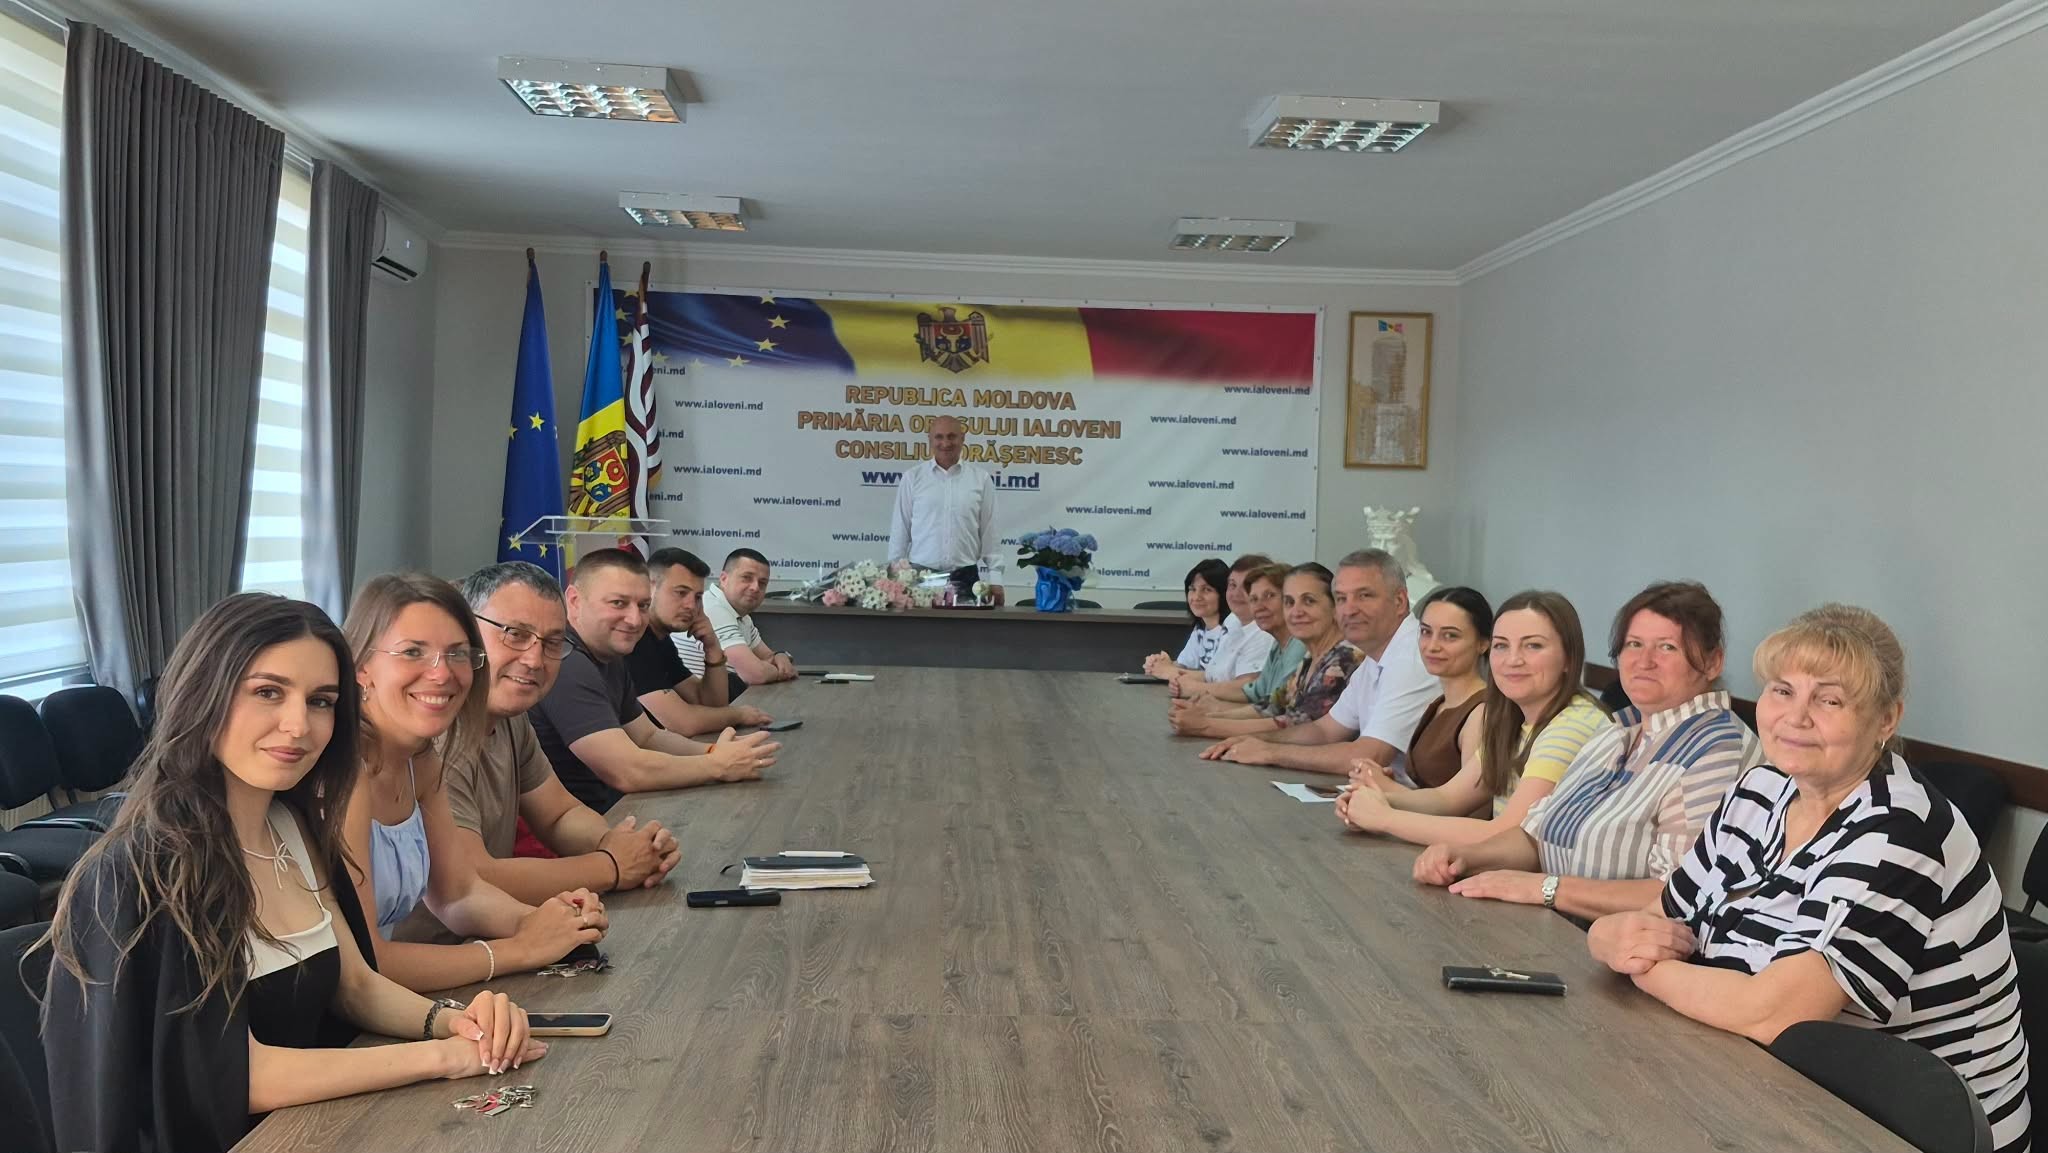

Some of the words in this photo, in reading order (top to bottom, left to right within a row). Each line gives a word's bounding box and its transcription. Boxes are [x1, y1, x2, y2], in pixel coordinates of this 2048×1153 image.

[1224, 384, 1311, 396] www.ialoveni.md
[845, 384, 967, 407] REPUBLICA
[973, 389, 1076, 411] MOLDOVA
[674, 399, 764, 411] www.ialoveni.md
[797, 408, 904, 432] PRIMĂRIA
[1023, 418, 1122, 439] IALOVENI
[1150, 414, 1237, 426] www.ialoveni.md
[835, 439, 934, 461] CONSILIU
[1222, 447, 1309, 458] www.ialoveni.md
[673, 464, 762, 476] www.ialoveni.md
[1148, 479, 1235, 490] www.ialoveni.md
[753, 496, 841, 507] www.ialoveni.md
[1065, 505, 1152, 516] www.ialoveni.md
[1220, 509, 1306, 520] www.ialoveni.md
[672, 527, 761, 538] www.ialoveni.md
[1146, 541, 1233, 552] www.ialoveni.md
[768, 558, 839, 569] w.ialoveni.md
